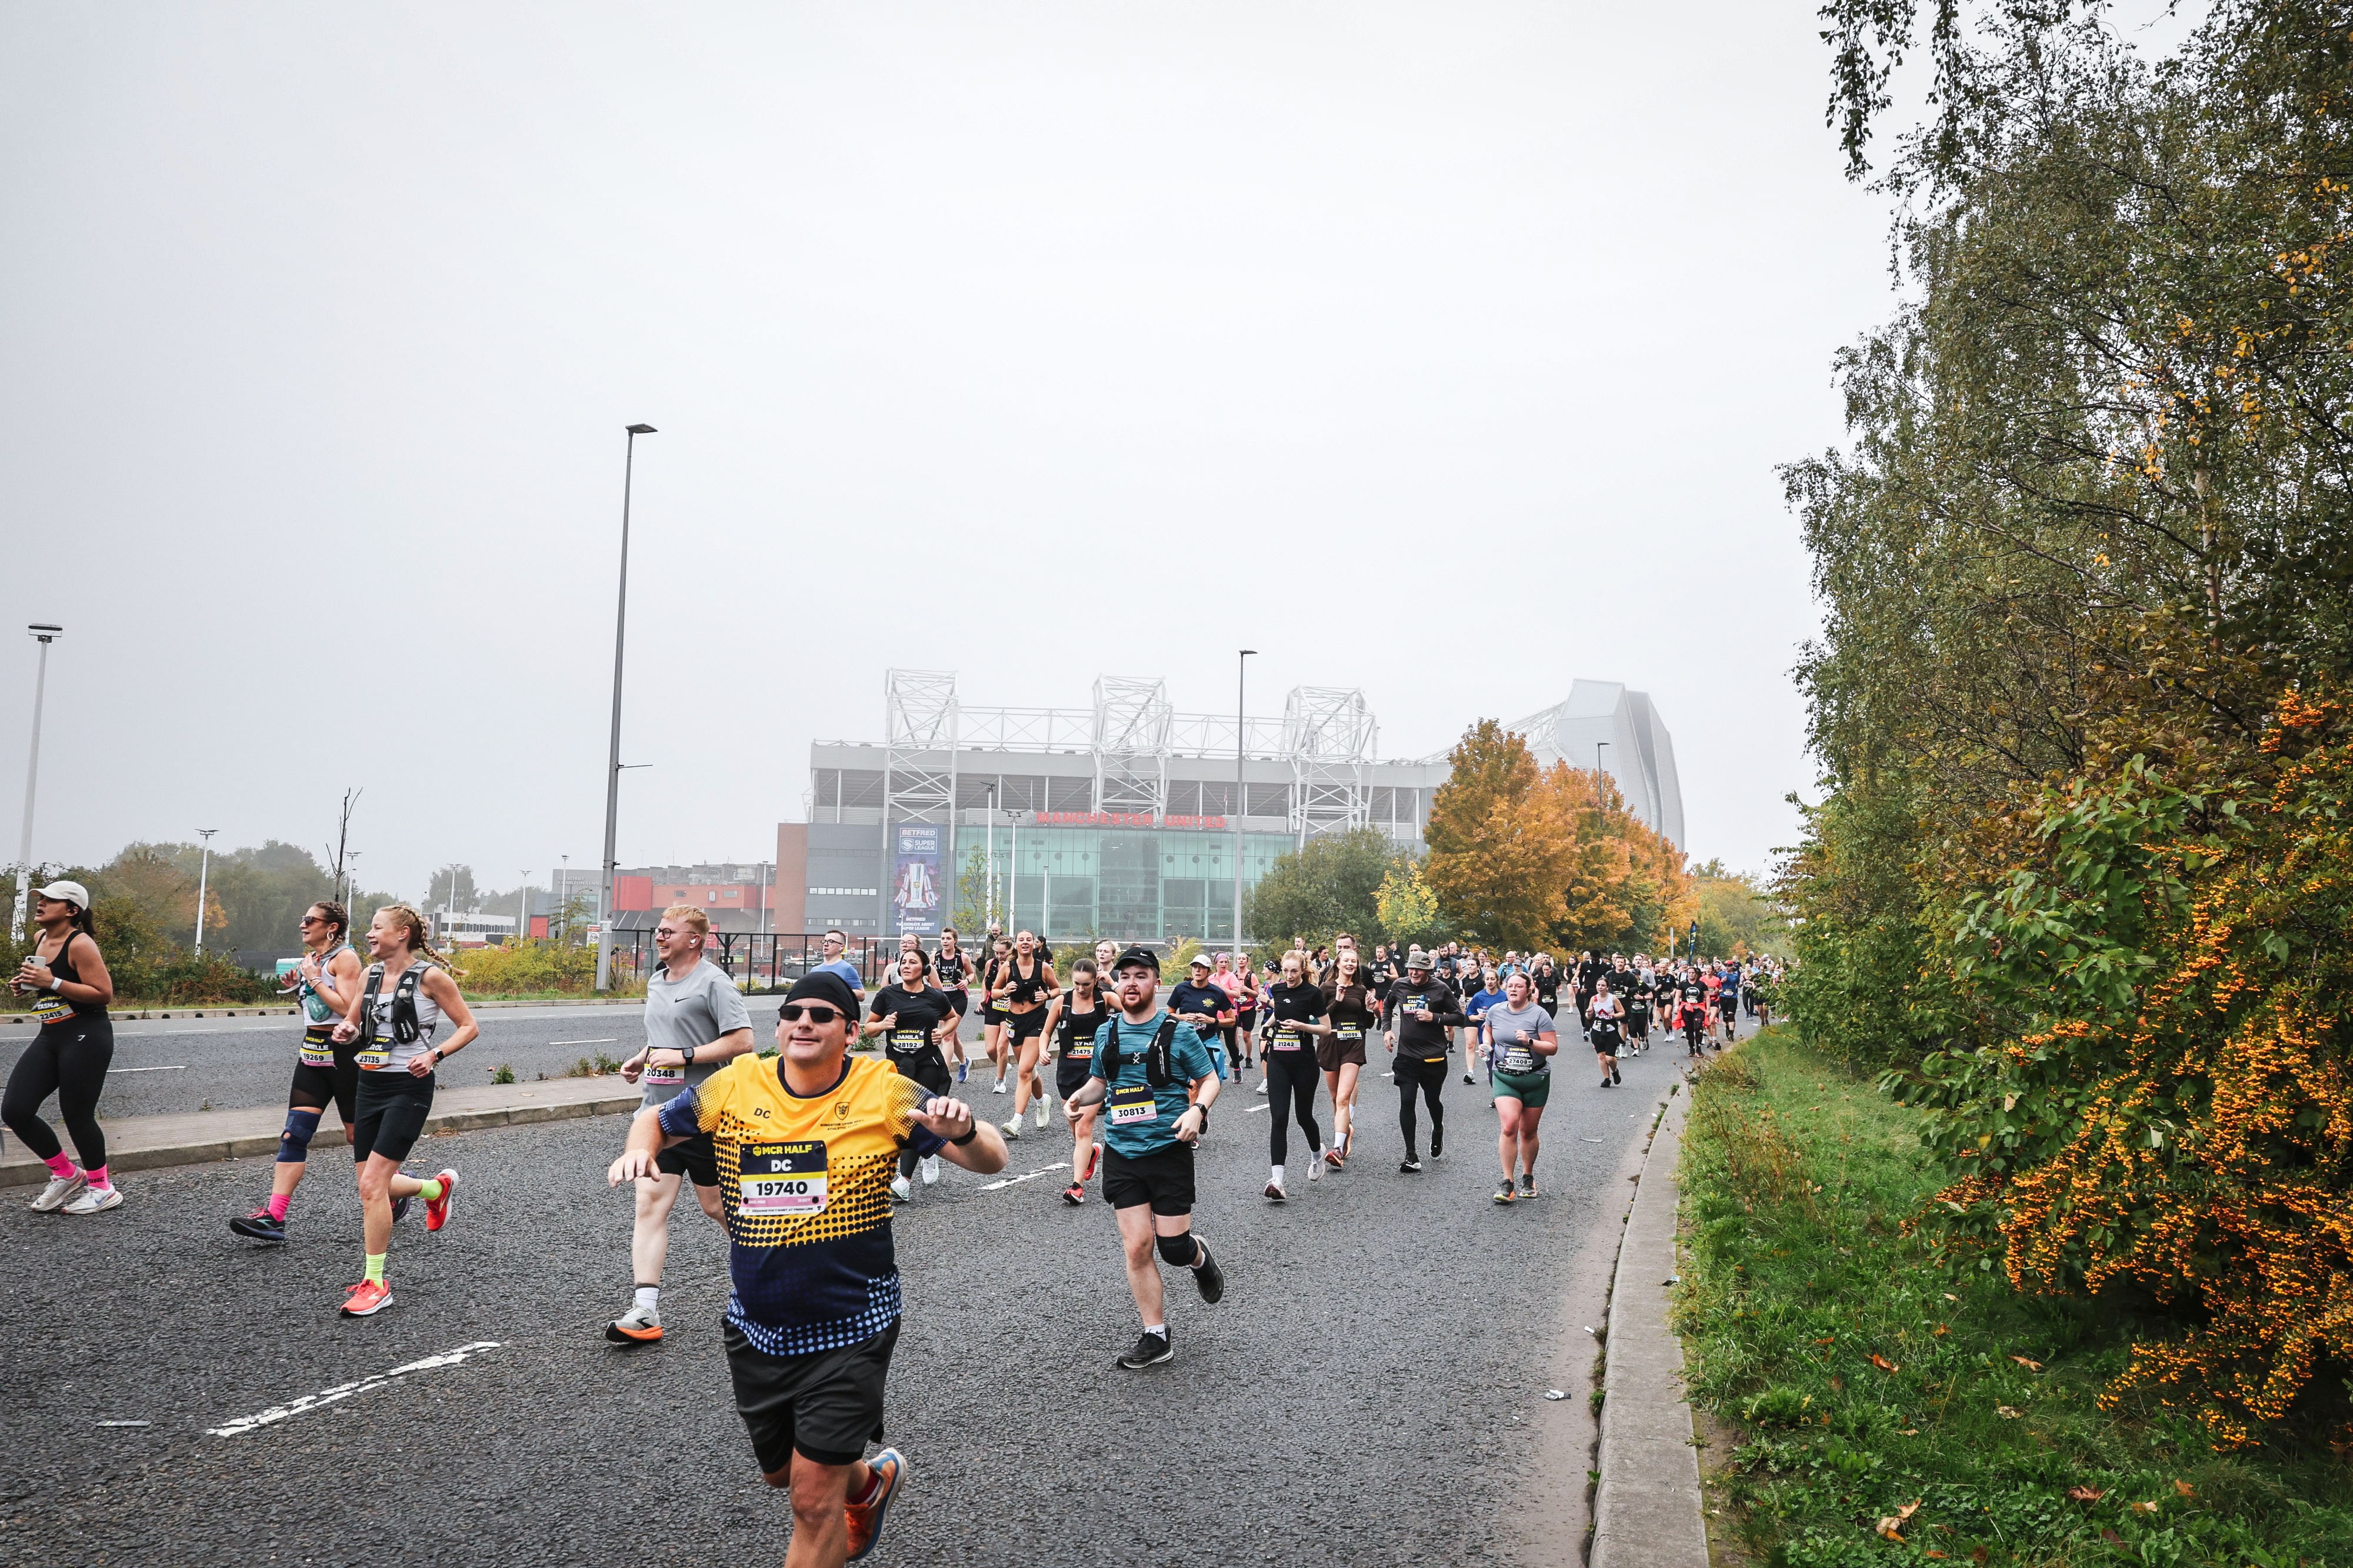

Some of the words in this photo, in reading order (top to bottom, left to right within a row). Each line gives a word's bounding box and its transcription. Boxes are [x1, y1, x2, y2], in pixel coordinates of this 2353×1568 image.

[1036, 812, 1153, 826] MANCHESTER
[1164, 814, 1226, 828] UNITED
[39, 1011, 63, 1020] 22415
[304, 1053, 324, 1062] 19269
[359, 1056, 380, 1064] 23135
[647, 1069, 675, 1078] 20348
[754, 1107, 771, 1119] DC
[1118, 1107, 1146, 1117] 30813
[762, 1146, 783, 1155] MCR
[784, 1144, 812, 1154] HALF
[771, 1159, 792, 1172] DC
[756, 1181, 808, 1196] 19740
